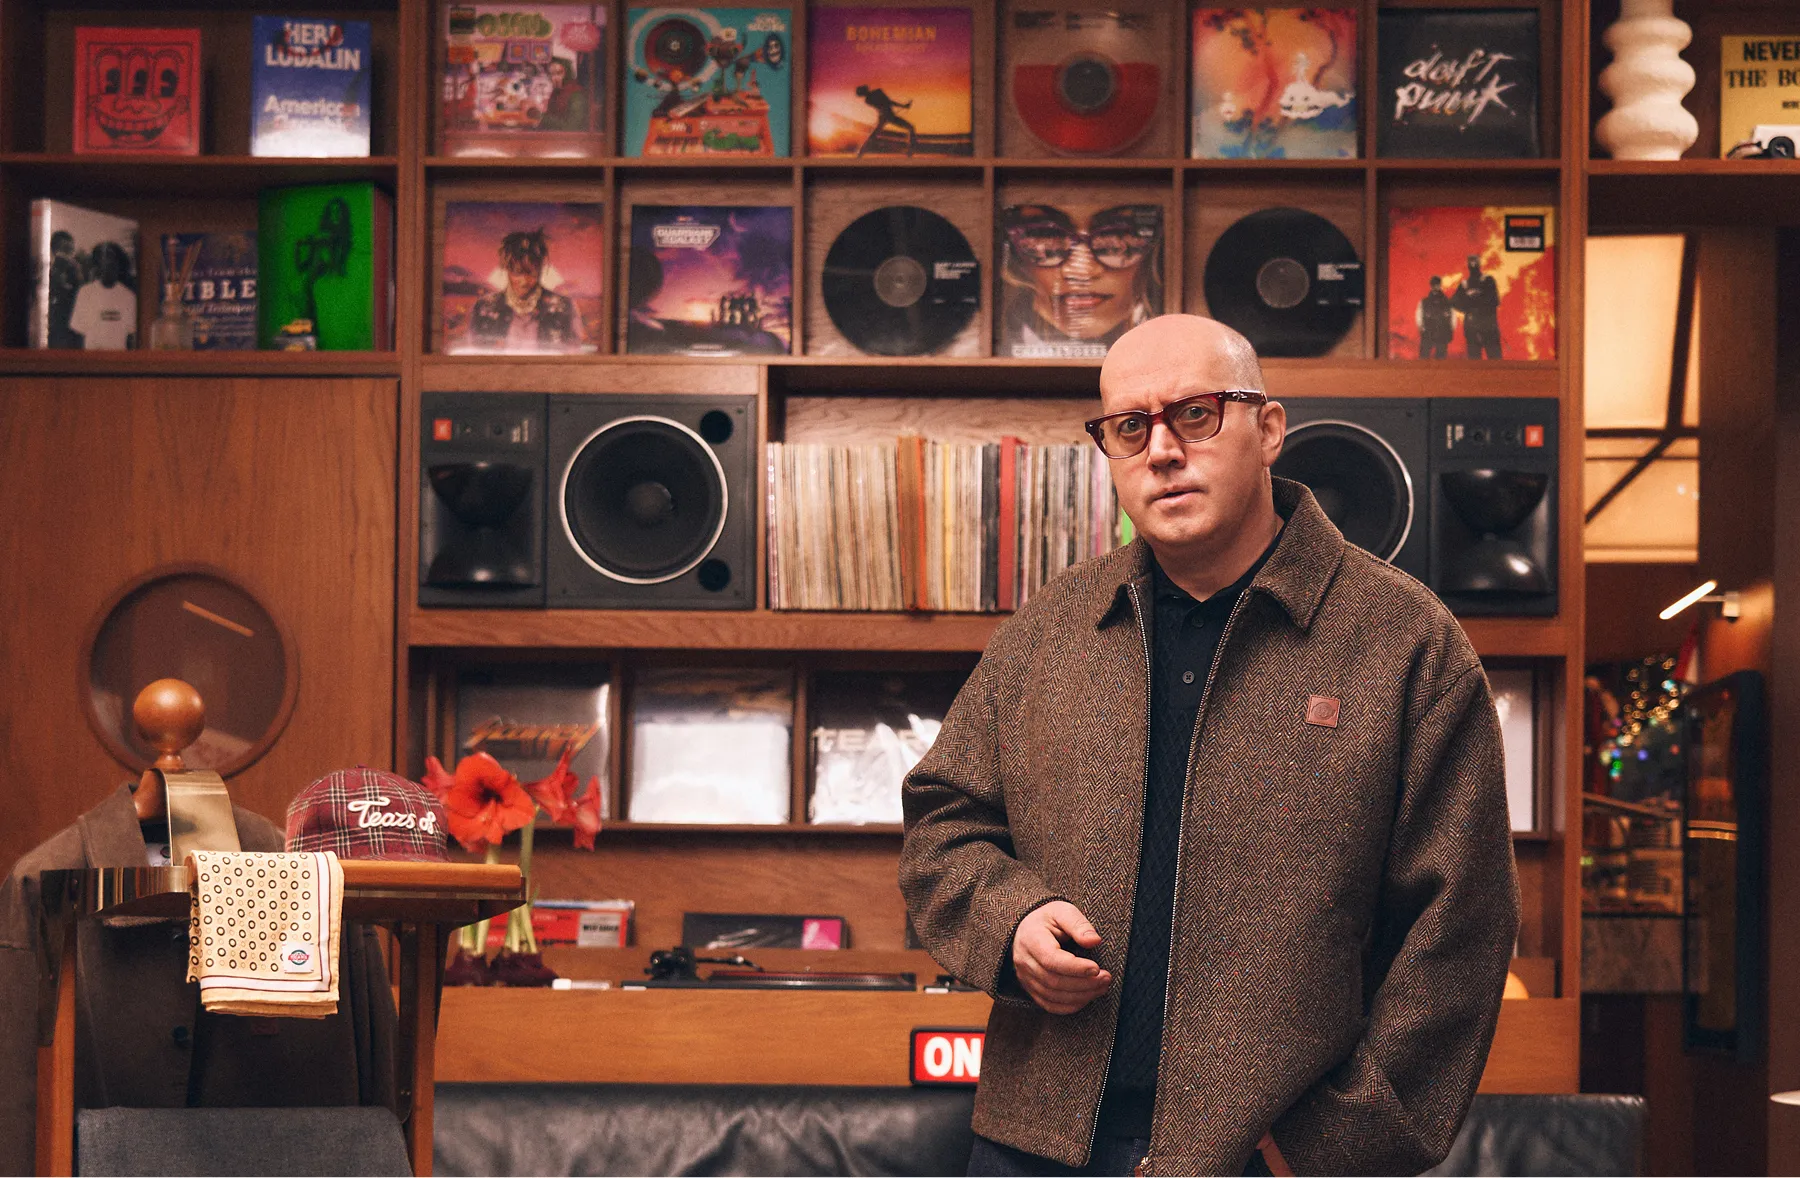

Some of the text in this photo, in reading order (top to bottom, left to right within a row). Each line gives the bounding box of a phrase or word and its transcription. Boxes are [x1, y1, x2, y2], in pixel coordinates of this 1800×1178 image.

[1725, 68, 1767, 89] THE
[348, 796, 437, 835] Tears of
[923, 1036, 982, 1078] ON
